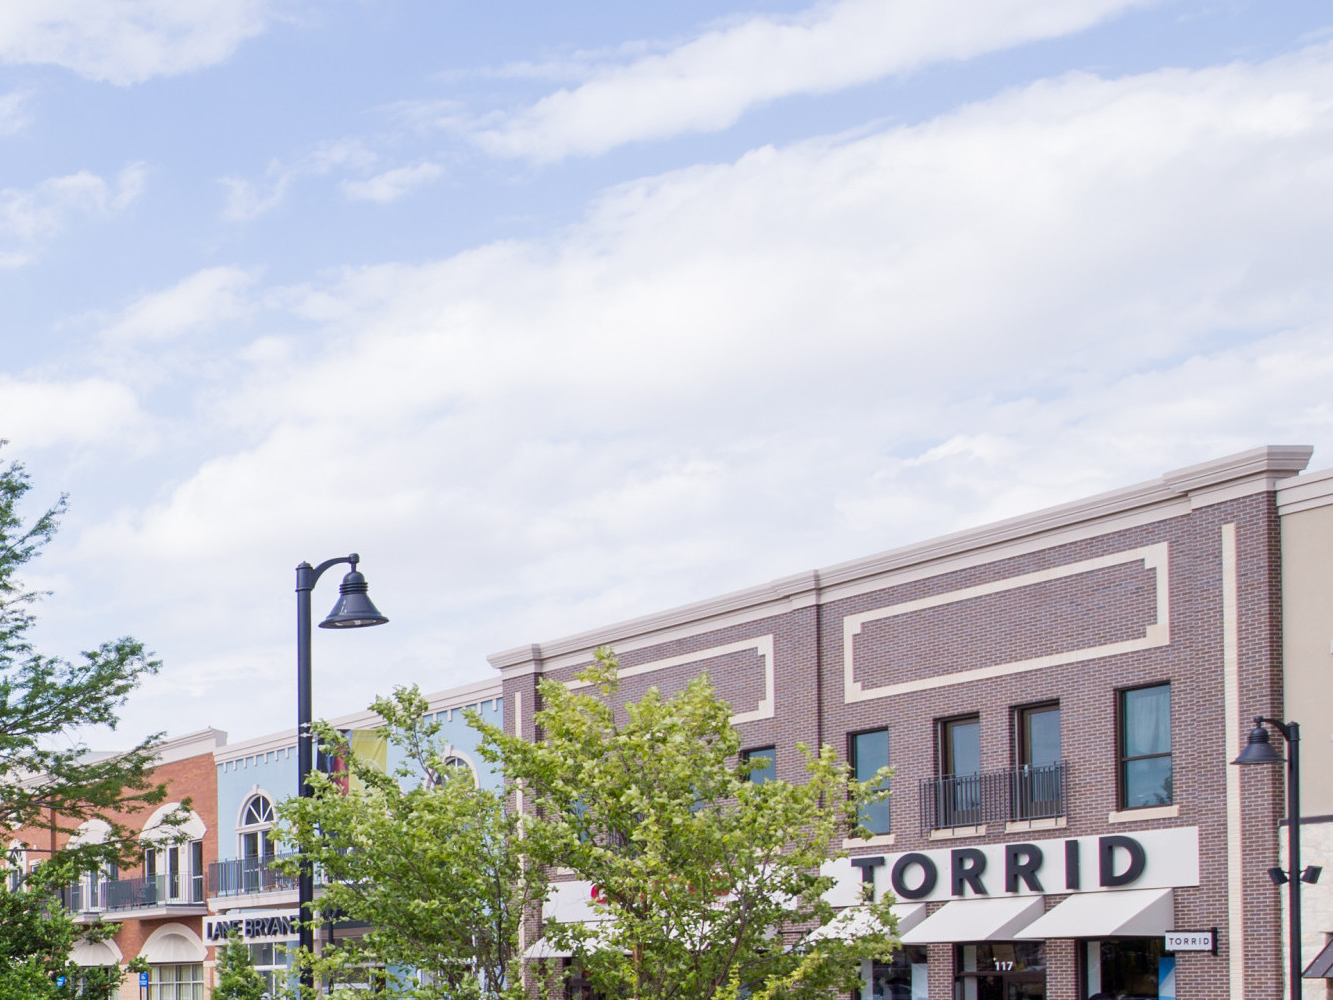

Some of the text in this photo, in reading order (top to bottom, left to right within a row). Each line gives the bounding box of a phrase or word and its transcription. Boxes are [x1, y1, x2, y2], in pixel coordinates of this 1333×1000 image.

[850, 834, 1146, 902] TORRID
[1169, 937, 1210, 946] TORRID
[994, 961, 1013, 971] 117
